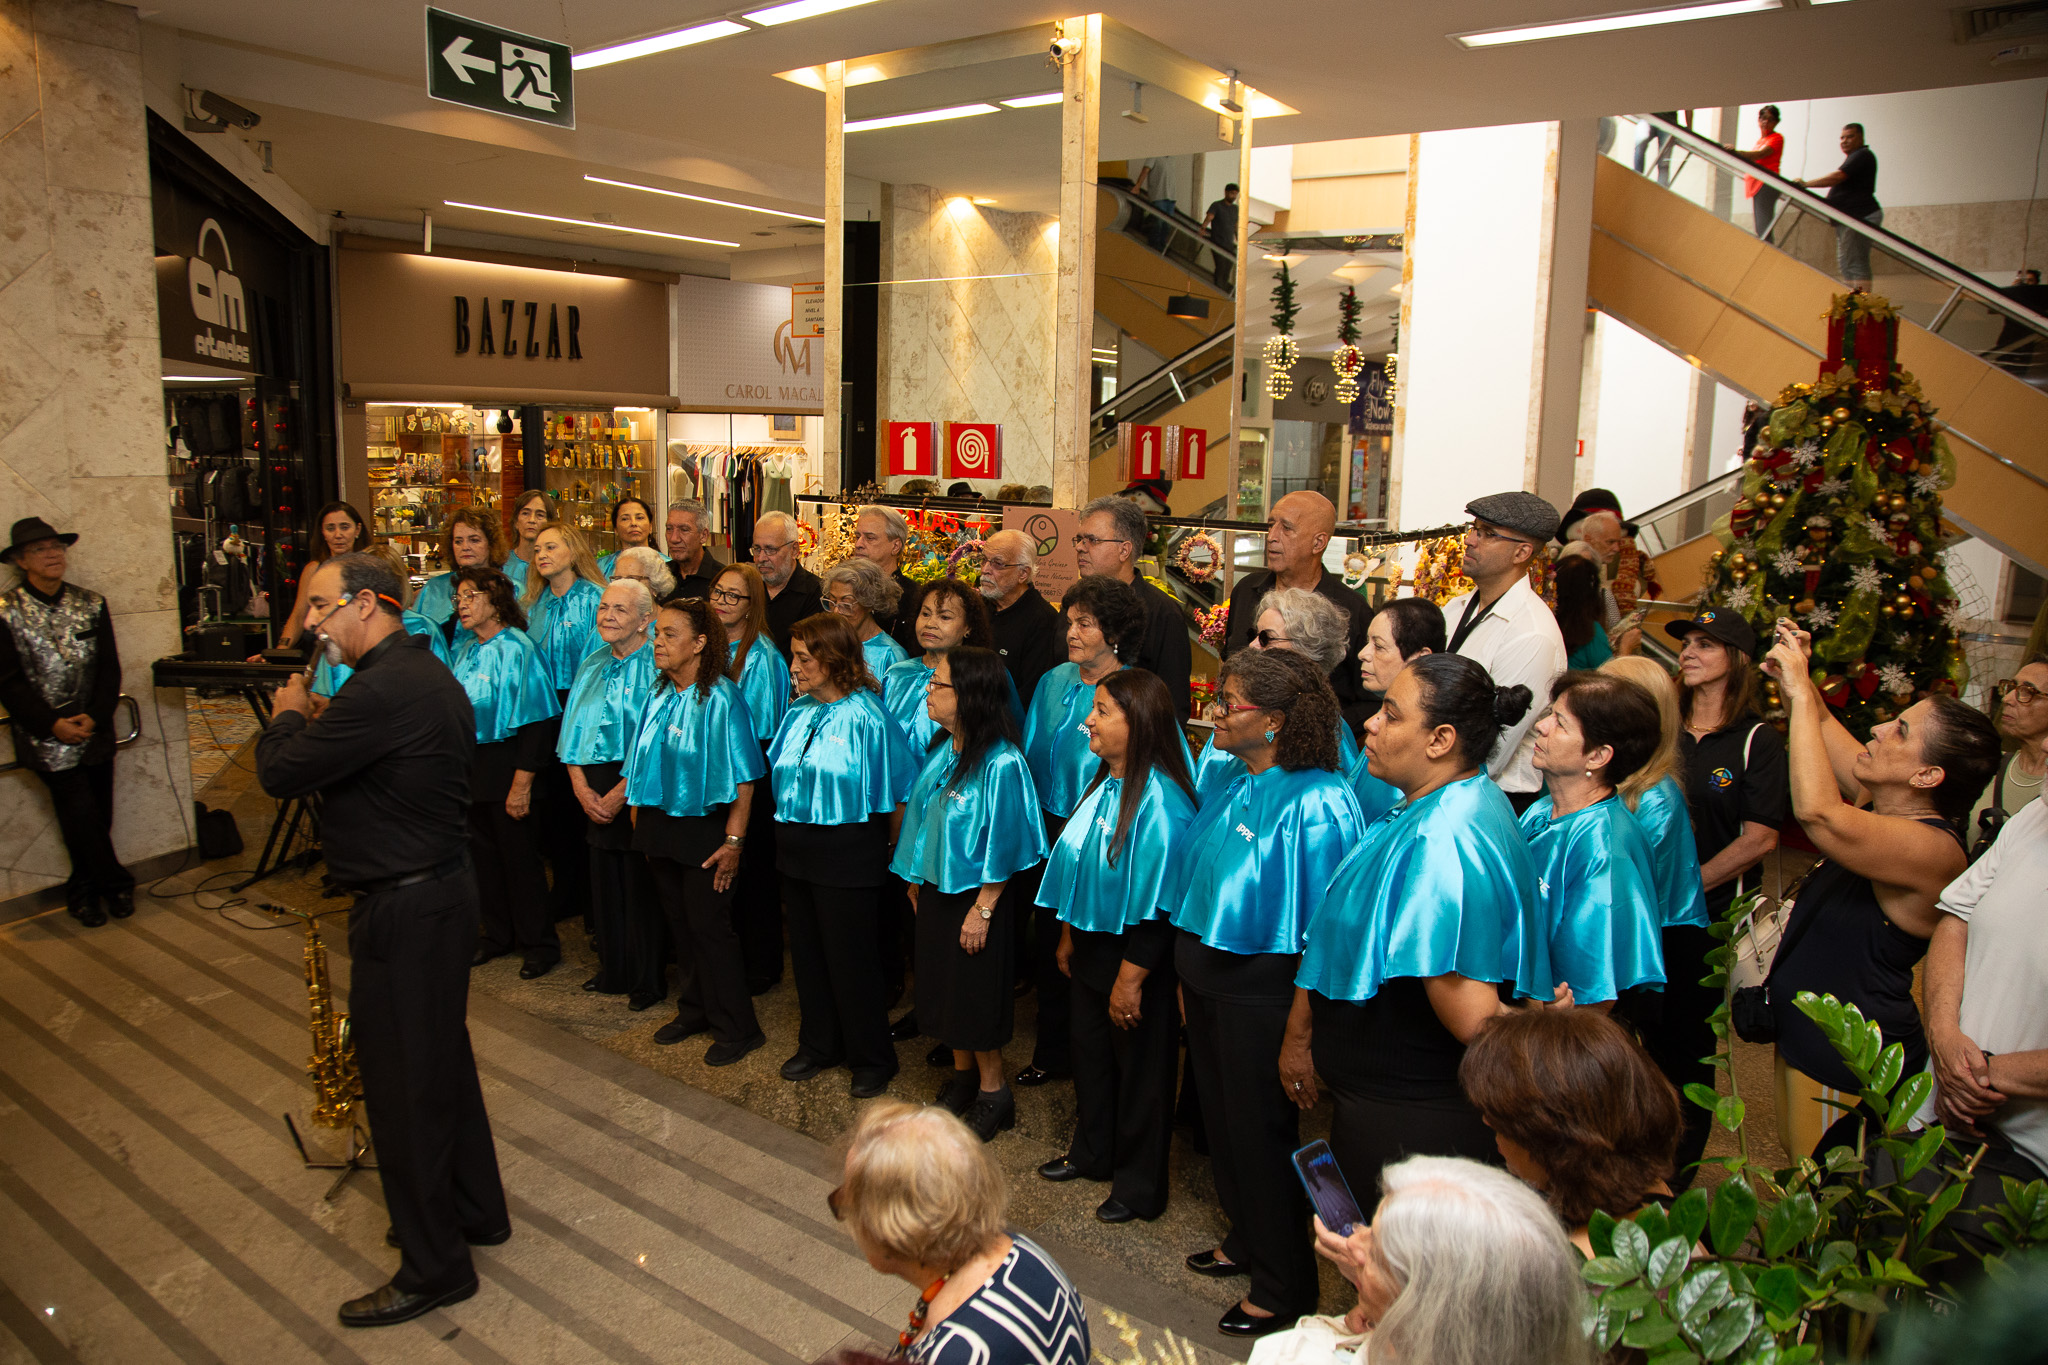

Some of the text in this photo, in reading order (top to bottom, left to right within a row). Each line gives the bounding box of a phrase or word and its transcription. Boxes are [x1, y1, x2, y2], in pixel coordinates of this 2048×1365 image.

[454, 295, 583, 360] BAZZAR
[726, 384, 772, 400] CAROL
[896, 509, 960, 533] ALAS
[668, 724, 683, 737] IPPE
[829, 735, 845, 746] IPPE
[1096, 816, 1111, 835] IPPE
[1235, 822, 1255, 842] IPPE
